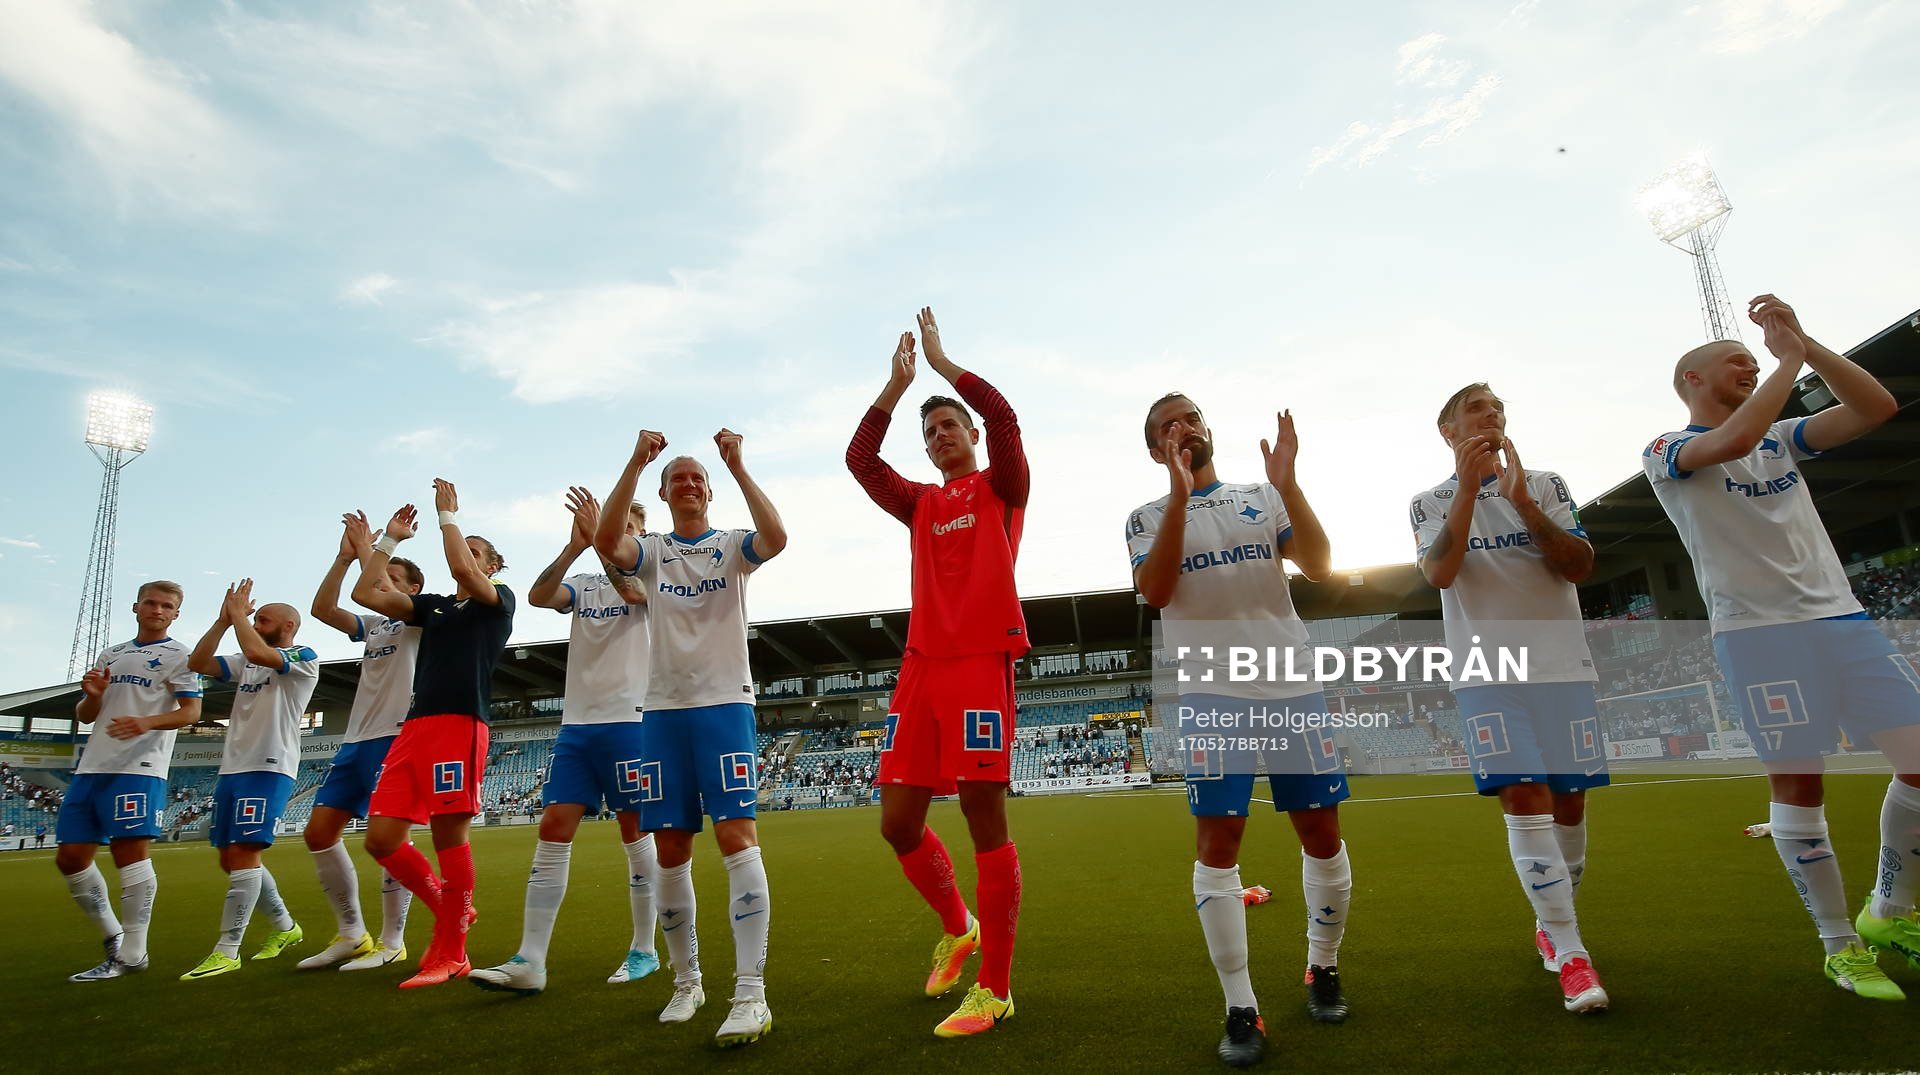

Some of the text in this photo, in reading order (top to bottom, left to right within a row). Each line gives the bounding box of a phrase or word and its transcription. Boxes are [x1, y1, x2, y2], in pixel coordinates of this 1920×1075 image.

[1186, 497, 1234, 511] stadium
[679, 546, 715, 556] tadium
[1180, 543, 1272, 575] HOLMEN
[1864, 560, 1871, 570] E
[659, 577, 727, 597] HOLMEN
[577, 605, 630, 619] HOLMEN
[1013, 686, 1096, 701] andelsbanken
[300, 741, 341, 753] venska ky
[1760, 731, 1783, 750] 17
[1016, 779, 1071, 789] 1893 1893
[234, 904, 248, 927] suez
